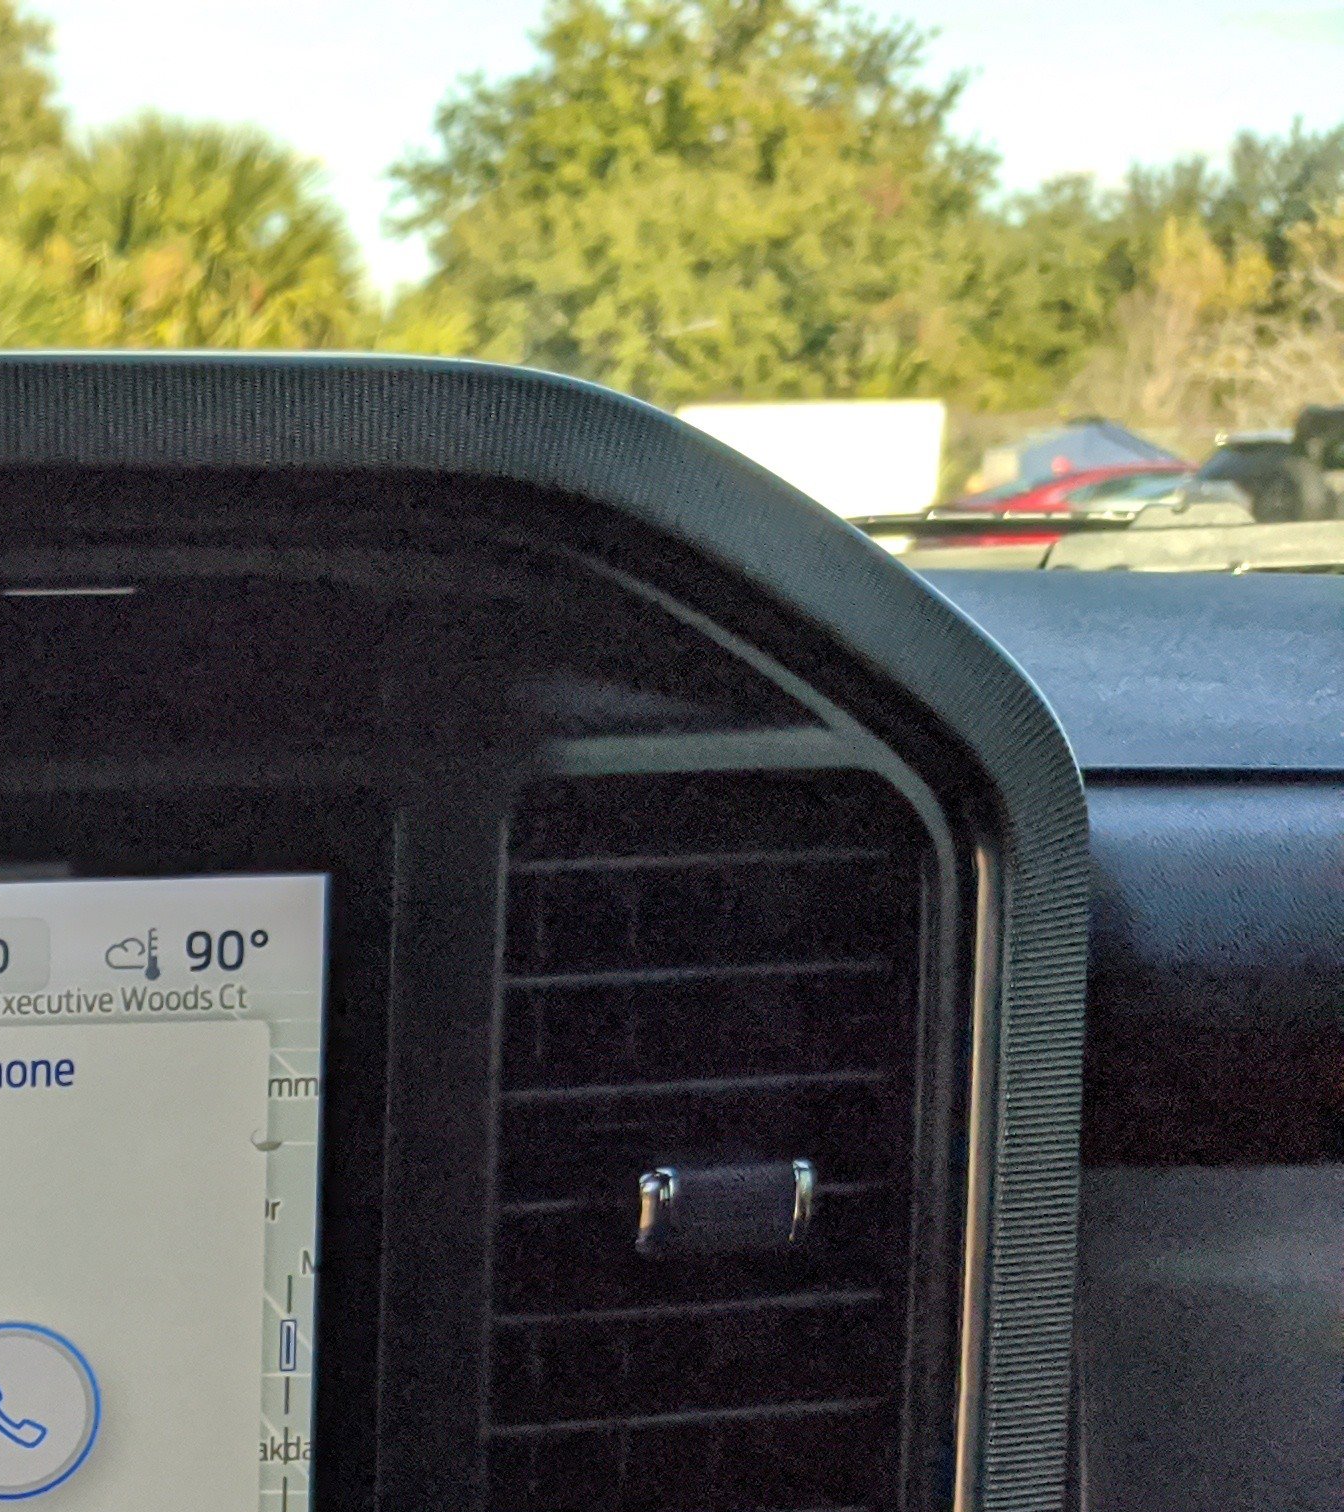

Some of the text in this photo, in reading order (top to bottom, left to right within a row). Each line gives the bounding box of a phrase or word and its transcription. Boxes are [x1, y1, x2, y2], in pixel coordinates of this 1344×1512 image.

[186, 929, 268, 973] 90°
[121, 985, 212, 1013] Woods
[218, 983, 247, 1010] Ct
